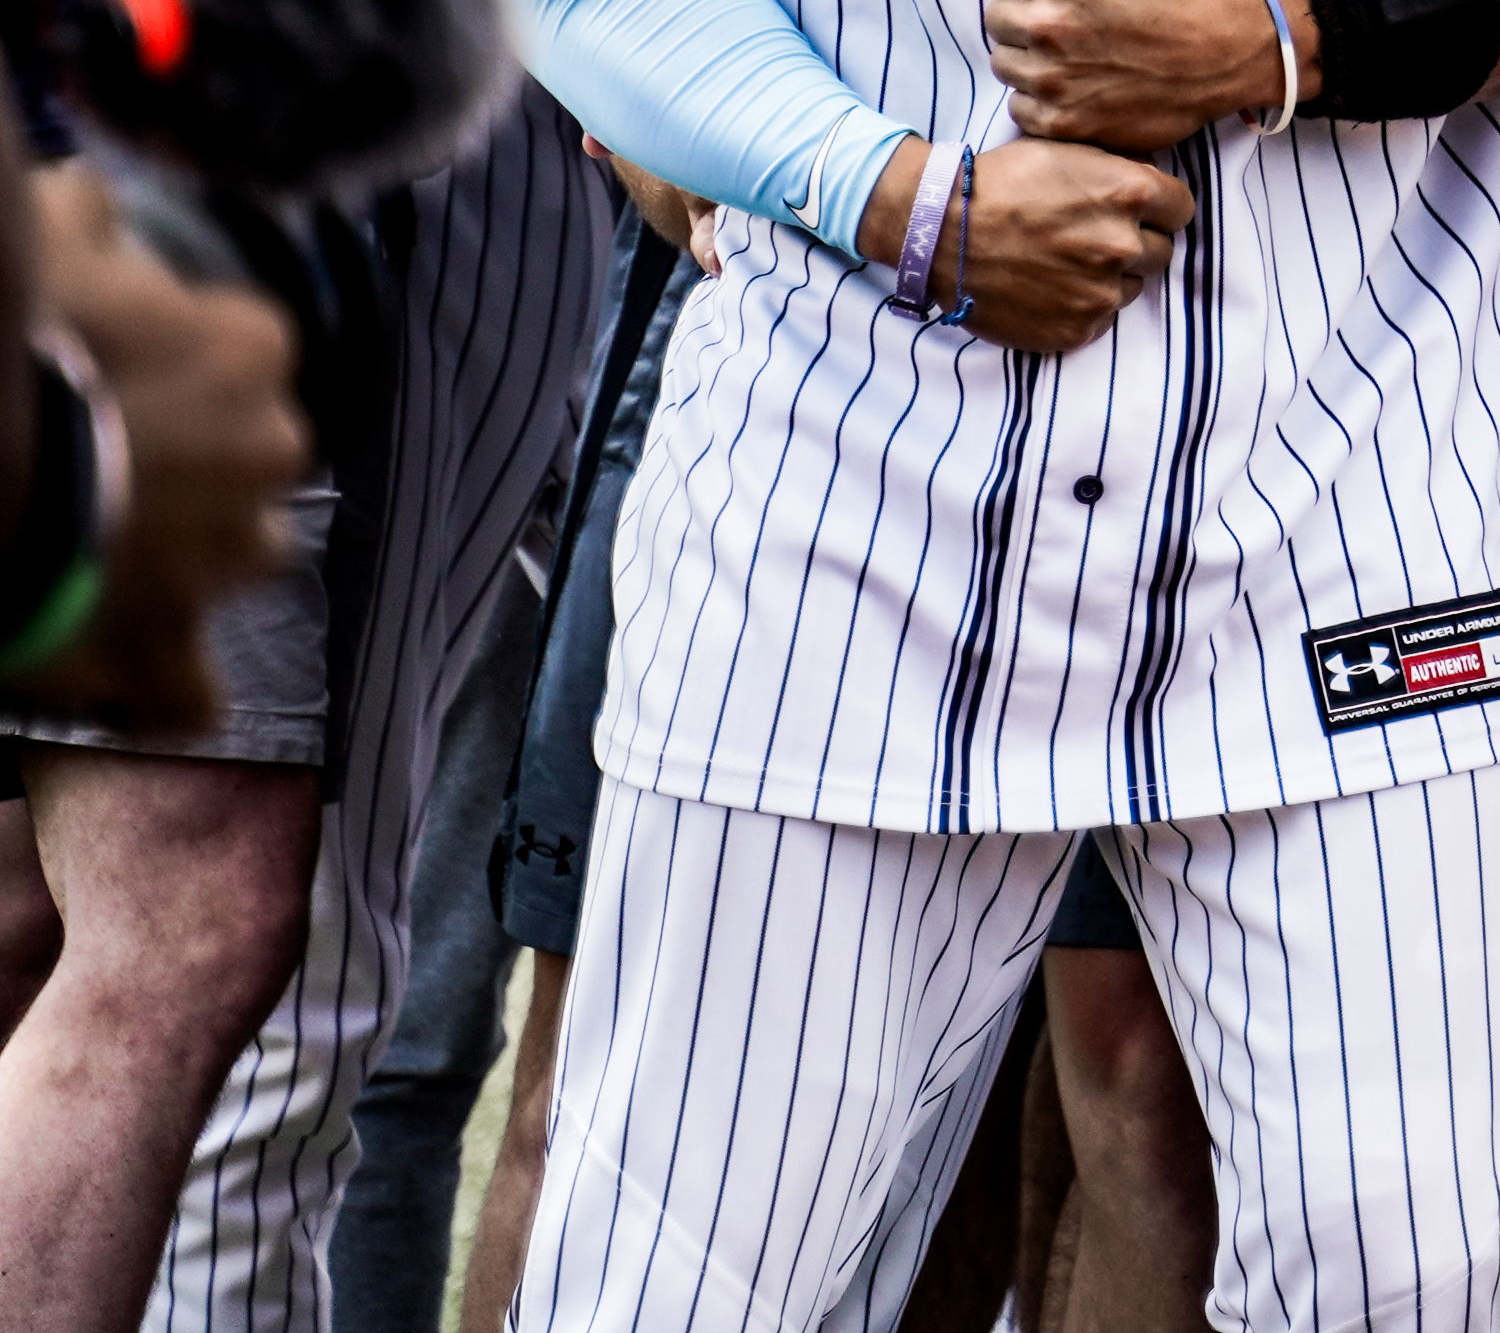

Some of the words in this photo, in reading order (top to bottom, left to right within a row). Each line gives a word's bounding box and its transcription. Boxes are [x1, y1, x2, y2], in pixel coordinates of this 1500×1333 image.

[1402, 626, 1455, 645] UNDER
[1409, 653, 1481, 684] AUTHENTIC
[1328, 703, 1390, 723] UNIVERSAL
[1391, 690, 1455, 710] GUARANTEE
[1457, 687, 1469, 696] OF
